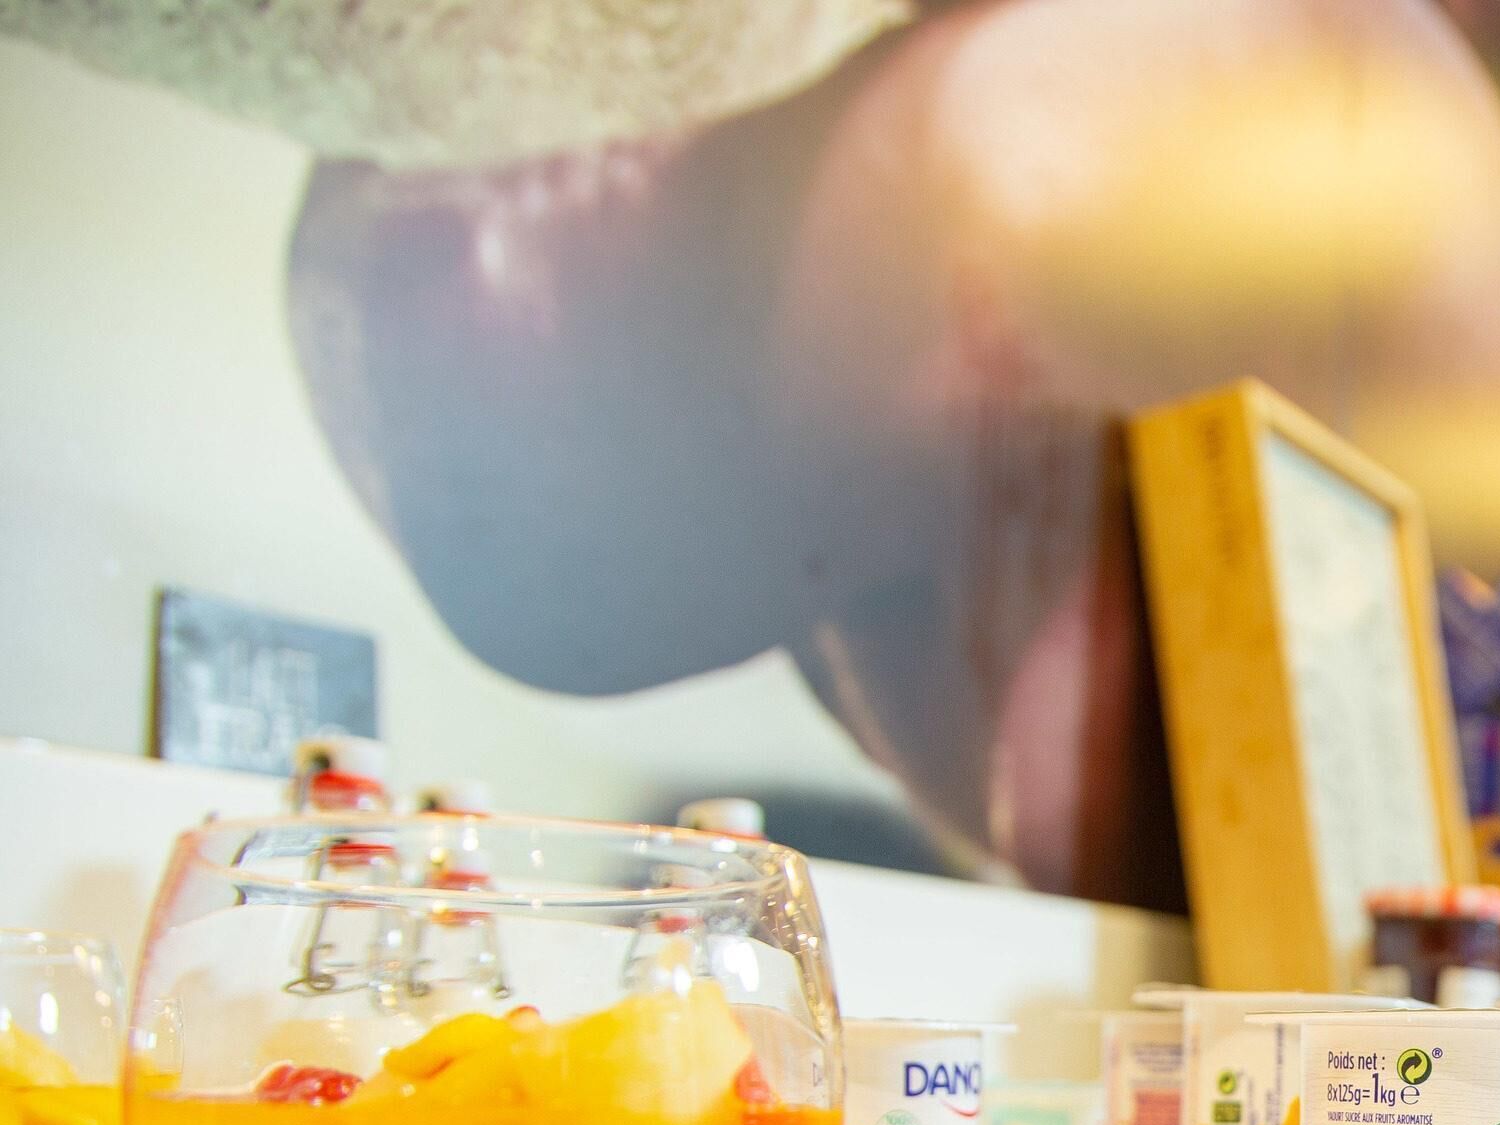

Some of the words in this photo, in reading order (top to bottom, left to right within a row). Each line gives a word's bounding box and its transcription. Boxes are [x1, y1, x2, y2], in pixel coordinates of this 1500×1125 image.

[1328, 1051, 1354, 1070] Poids
[1358, 1053, 1377, 1070] net
[1345, 1111, 1361, 1122] SUCRÉ
[1363, 1113, 1374, 1123] AUX
[1375, 1113, 1395, 1124] FRUITS
[1397, 1114, 1433, 1125] AROMATISÉ
